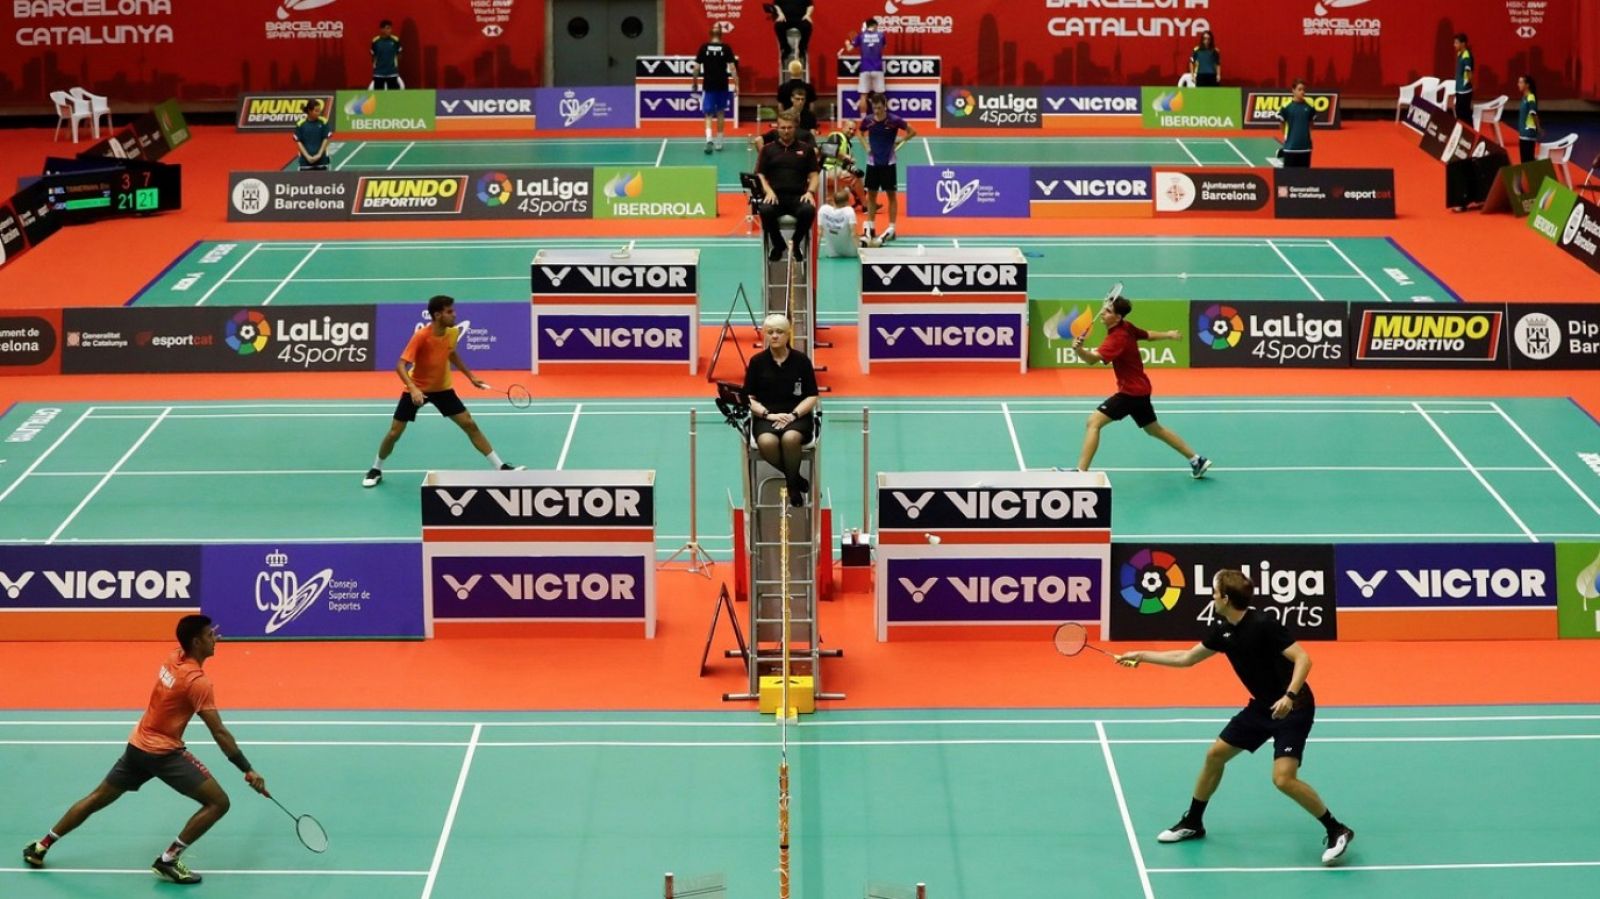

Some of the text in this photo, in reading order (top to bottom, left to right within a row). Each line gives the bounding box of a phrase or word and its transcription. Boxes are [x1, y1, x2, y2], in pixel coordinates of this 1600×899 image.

[14, 0, 172, 18] BARCELONA
[265, 21, 344, 31] BARCELONA
[1047, 17, 1210, 37] CATALUNYA
[1303, 18, 1382, 29] BARCELONA
[15, 25, 174, 46] CATALUNYA
[881, 60, 935, 75] ICTOR
[463, 99, 531, 114] VICTOR
[978, 95, 1038, 110] LaLiga
[1069, 97, 1138, 112] VICTOR
[351, 118, 427, 130] IBERDROLA
[979, 110, 1038, 126] 4Sports
[1160, 115, 1234, 128] IBERDROLA
[122, 173, 131, 190] 3
[142, 171, 151, 187] 7
[365, 179, 458, 197] MUNDO
[516, 177, 589, 199] LaLiga
[1063, 179, 1147, 196] VICTOR
[1202, 181, 1244, 193] Ajuntament
[274, 183, 345, 199] Diputació
[1201, 190, 1257, 202] Barcelona
[1344, 189, 1392, 200] esportcat
[117, 193, 134, 210] 21
[138, 191, 155, 207] 21
[274, 197, 345, 210] Barcelona
[363, 197, 438, 208] DEPORTIVO
[517, 199, 587, 215] 4Sports
[613, 202, 706, 216] IBERDROLA
[577, 266, 687, 288] VICTOR
[908, 264, 1018, 286] VICTOR
[27, 328, 40, 337] de
[277, 316, 369, 346] LaLiga
[911, 325, 1014, 346] VICTOR
[1249, 312, 1343, 343] LaLiga
[1372, 315, 1489, 340] MUNDO
[82, 332, 121, 341] Generalitat
[82, 339, 128, 349] de Catalunya
[151, 335, 213, 348] esportcat
[580, 327, 683, 348] VICTOR
[1370, 338, 1465, 351] DEPORTIVO
[0, 339, 40, 352] elona
[1252, 340, 1342, 364] 4Sports
[1569, 338, 1600, 354] Bar
[277, 344, 367, 367] 4Sports
[485, 488, 641, 518] VICTOR
[943, 490, 1099, 520] VICTOR
[42, 569, 192, 600] VICTOR
[328, 579, 358, 592] Consejo
[490, 573, 636, 601] VICTOR
[947, 575, 1092, 604] VICTOR
[1194, 560, 1325, 603] Liga
[1395, 568, 1546, 599] VICTOR
[255, 571, 298, 612] CSD
[328, 590, 371, 604] Superior de
[328, 601, 361, 614] Deportes
[1196, 601, 1324, 627] 4rts
